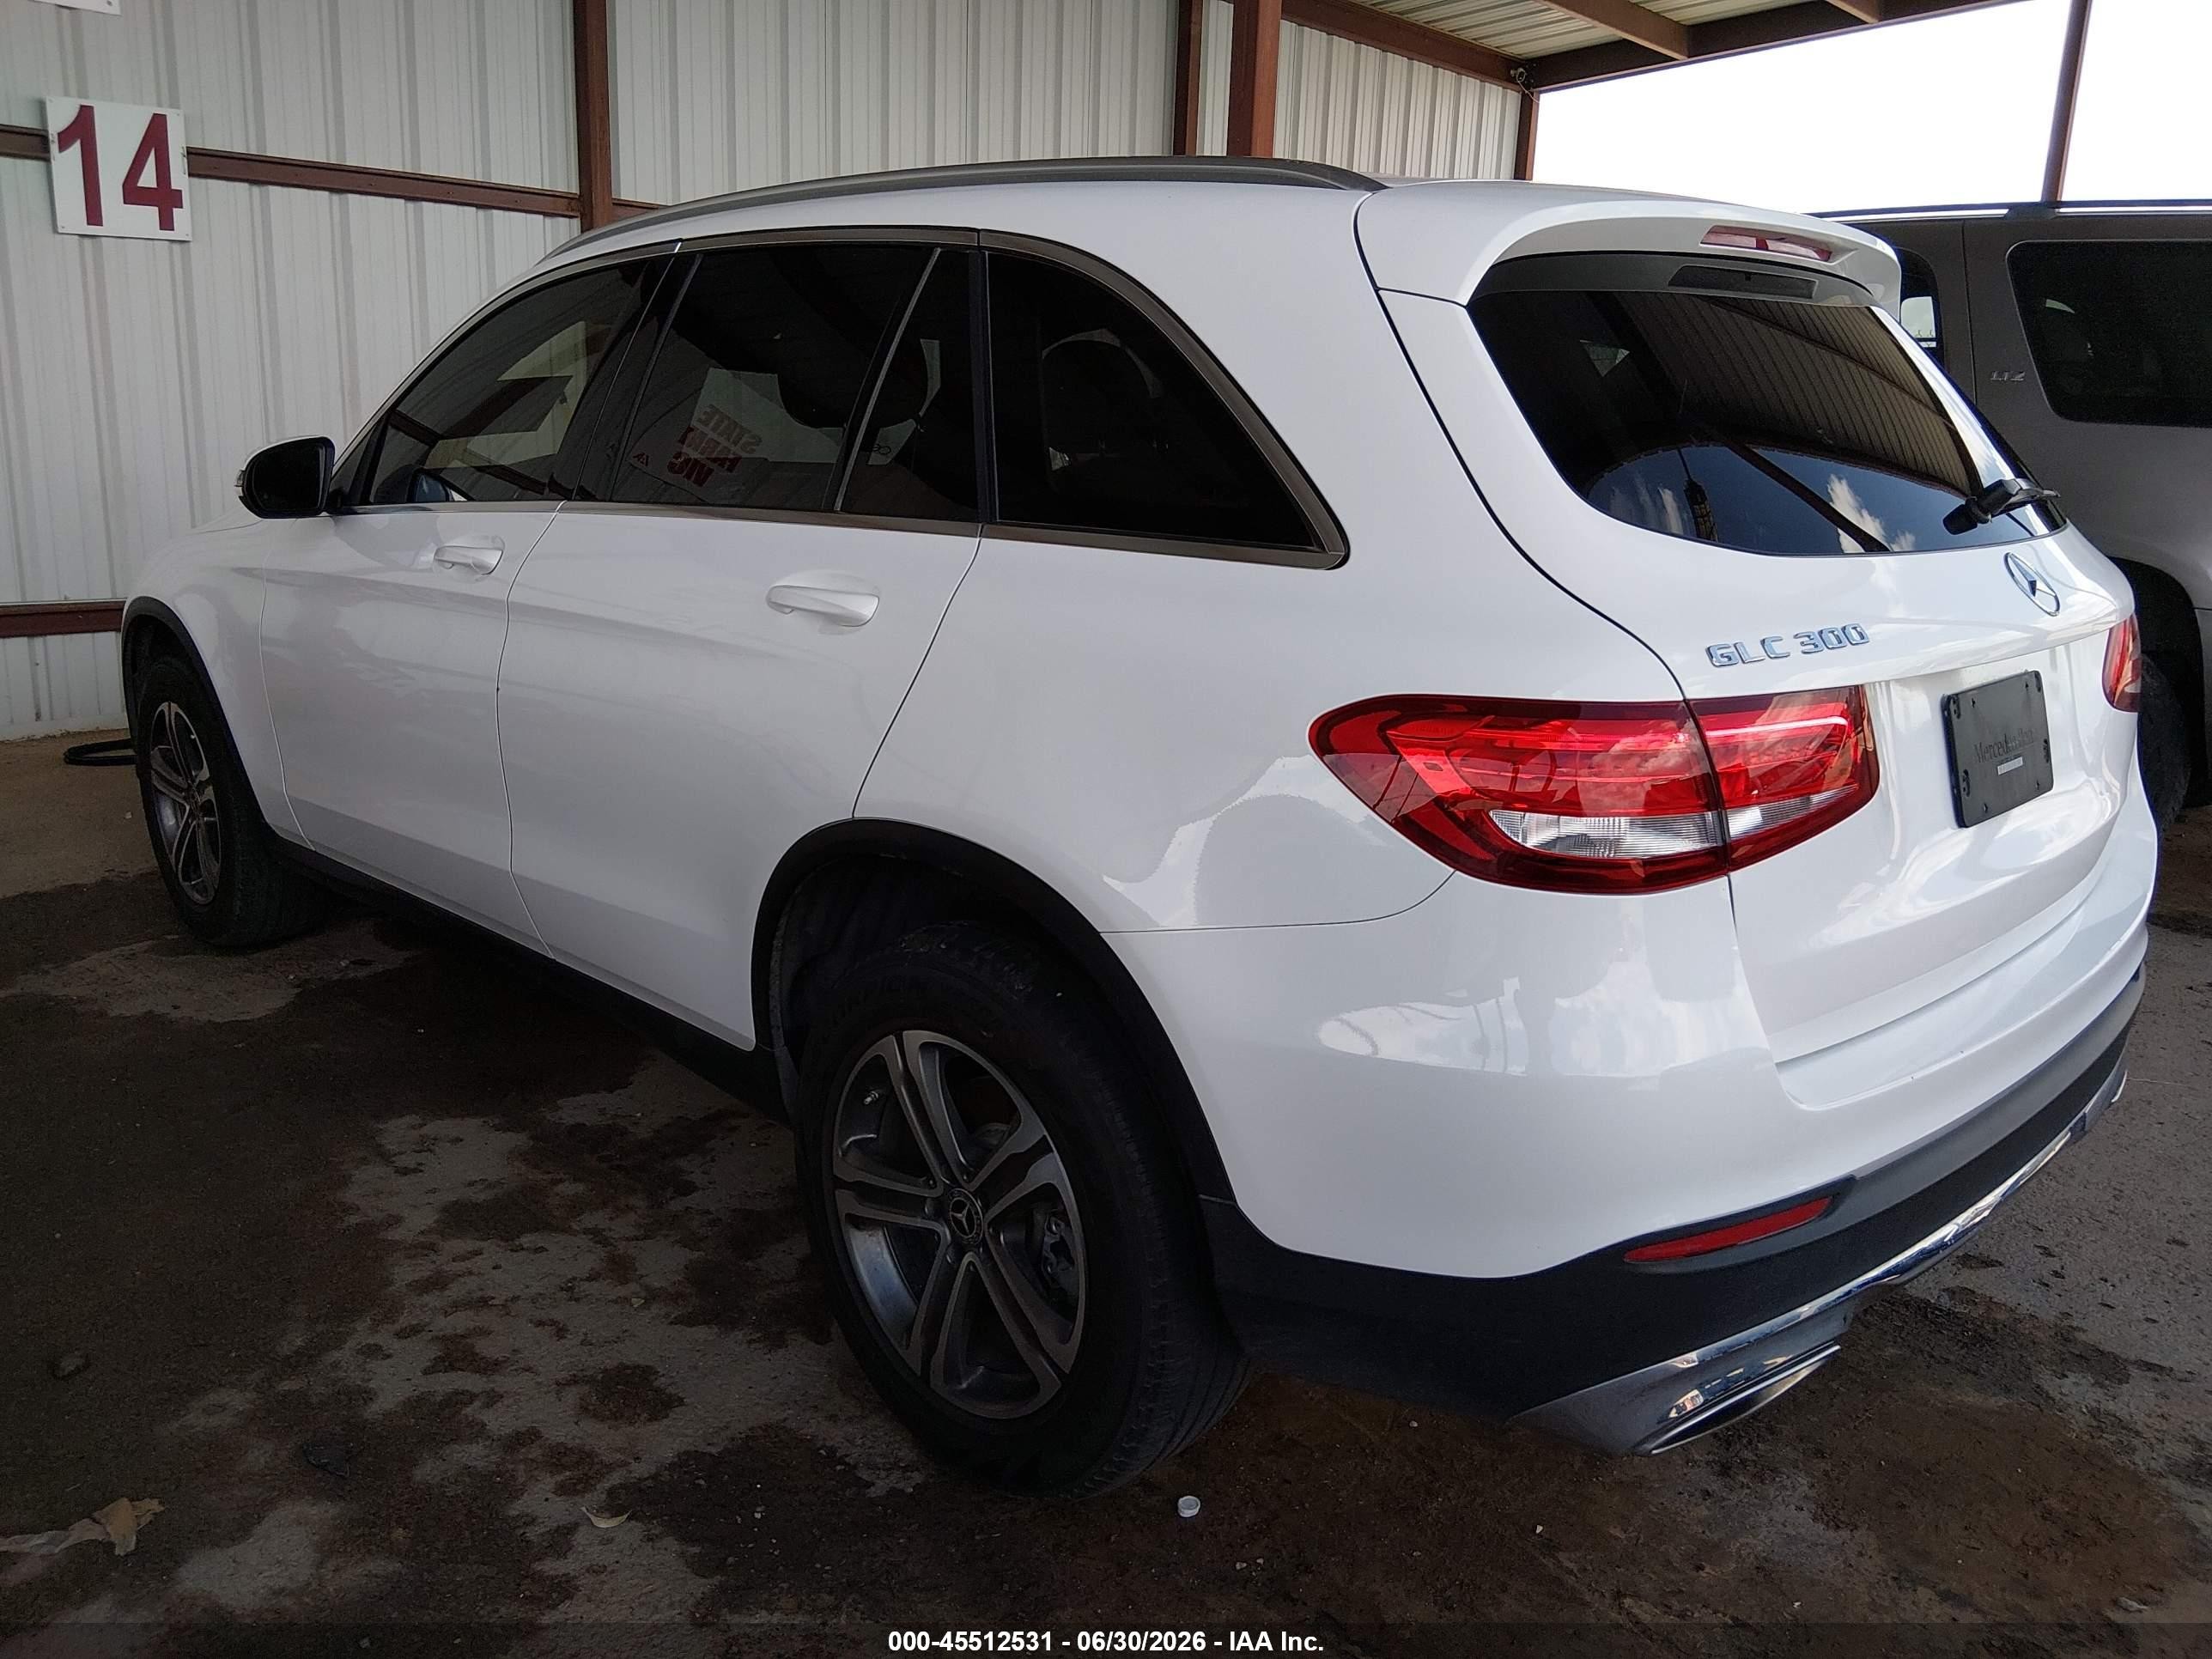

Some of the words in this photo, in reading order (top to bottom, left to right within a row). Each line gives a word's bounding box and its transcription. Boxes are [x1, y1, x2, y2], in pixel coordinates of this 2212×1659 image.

[58, 104, 183, 230] 14
[1705, 635, 1790, 667] GLC
[1793, 623, 1870, 654] 300
